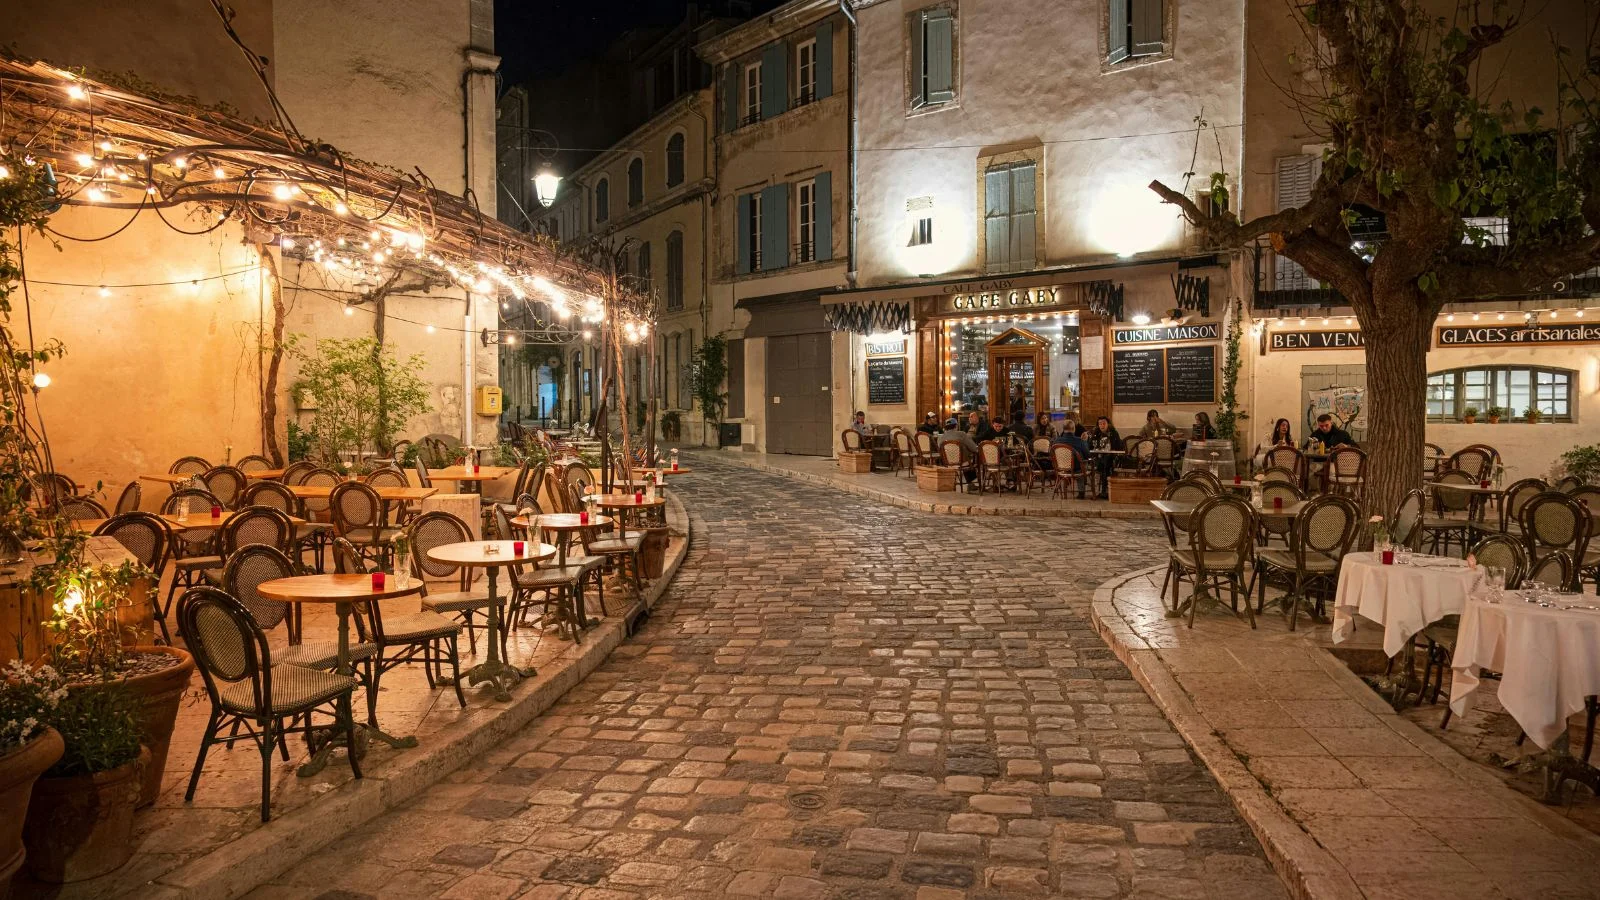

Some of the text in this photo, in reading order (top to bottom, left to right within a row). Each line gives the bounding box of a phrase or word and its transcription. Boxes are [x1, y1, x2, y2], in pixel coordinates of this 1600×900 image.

[980, 280, 1015, 291] GABY
[953, 288, 1058, 310] CAFE GABY
[1117, 325, 1217, 342] CUISINE MAISON
[1273, 332, 1365, 347] BEN VEN
[1442, 325, 1600, 343] GLACES artisanales
[868, 342, 903, 354] BISTROT
